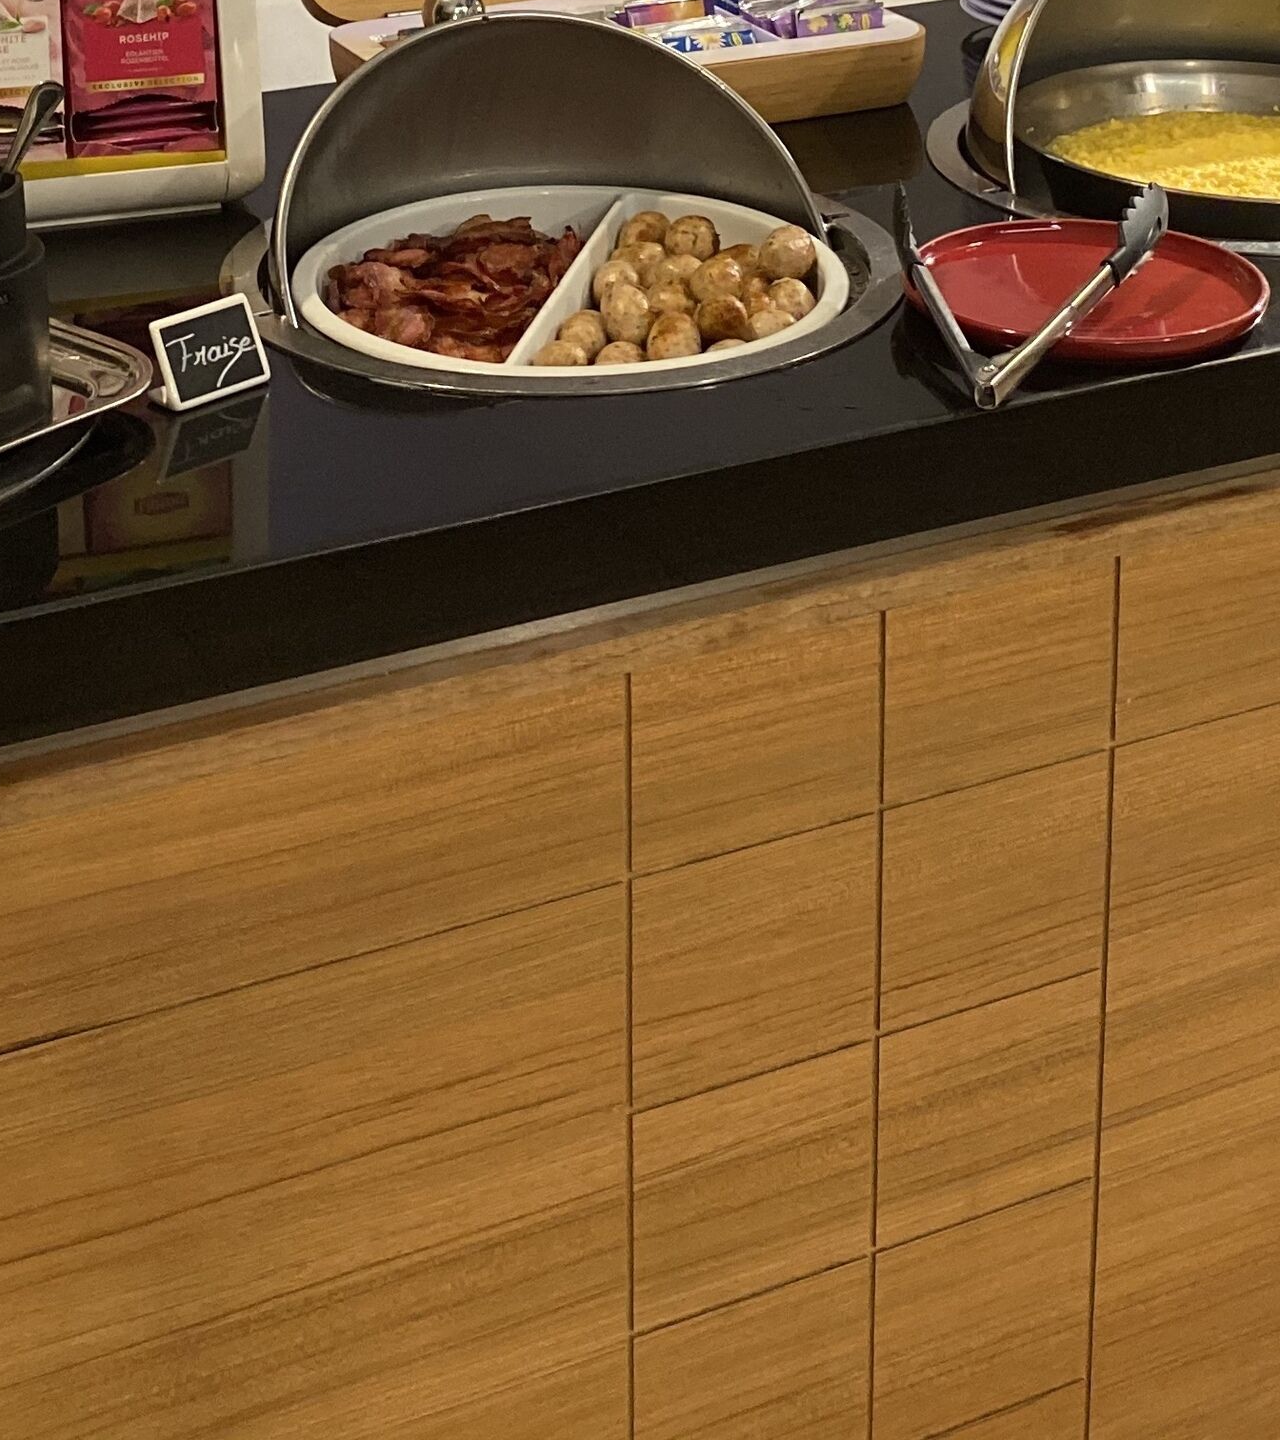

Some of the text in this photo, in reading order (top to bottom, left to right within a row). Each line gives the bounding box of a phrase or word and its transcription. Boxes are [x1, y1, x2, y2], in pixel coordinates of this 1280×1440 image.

[119, 32, 169, 44] ROSEHIP
[91, 81, 145, 90] EXCLUSIVE
[165, 333, 257, 388] Fraise
